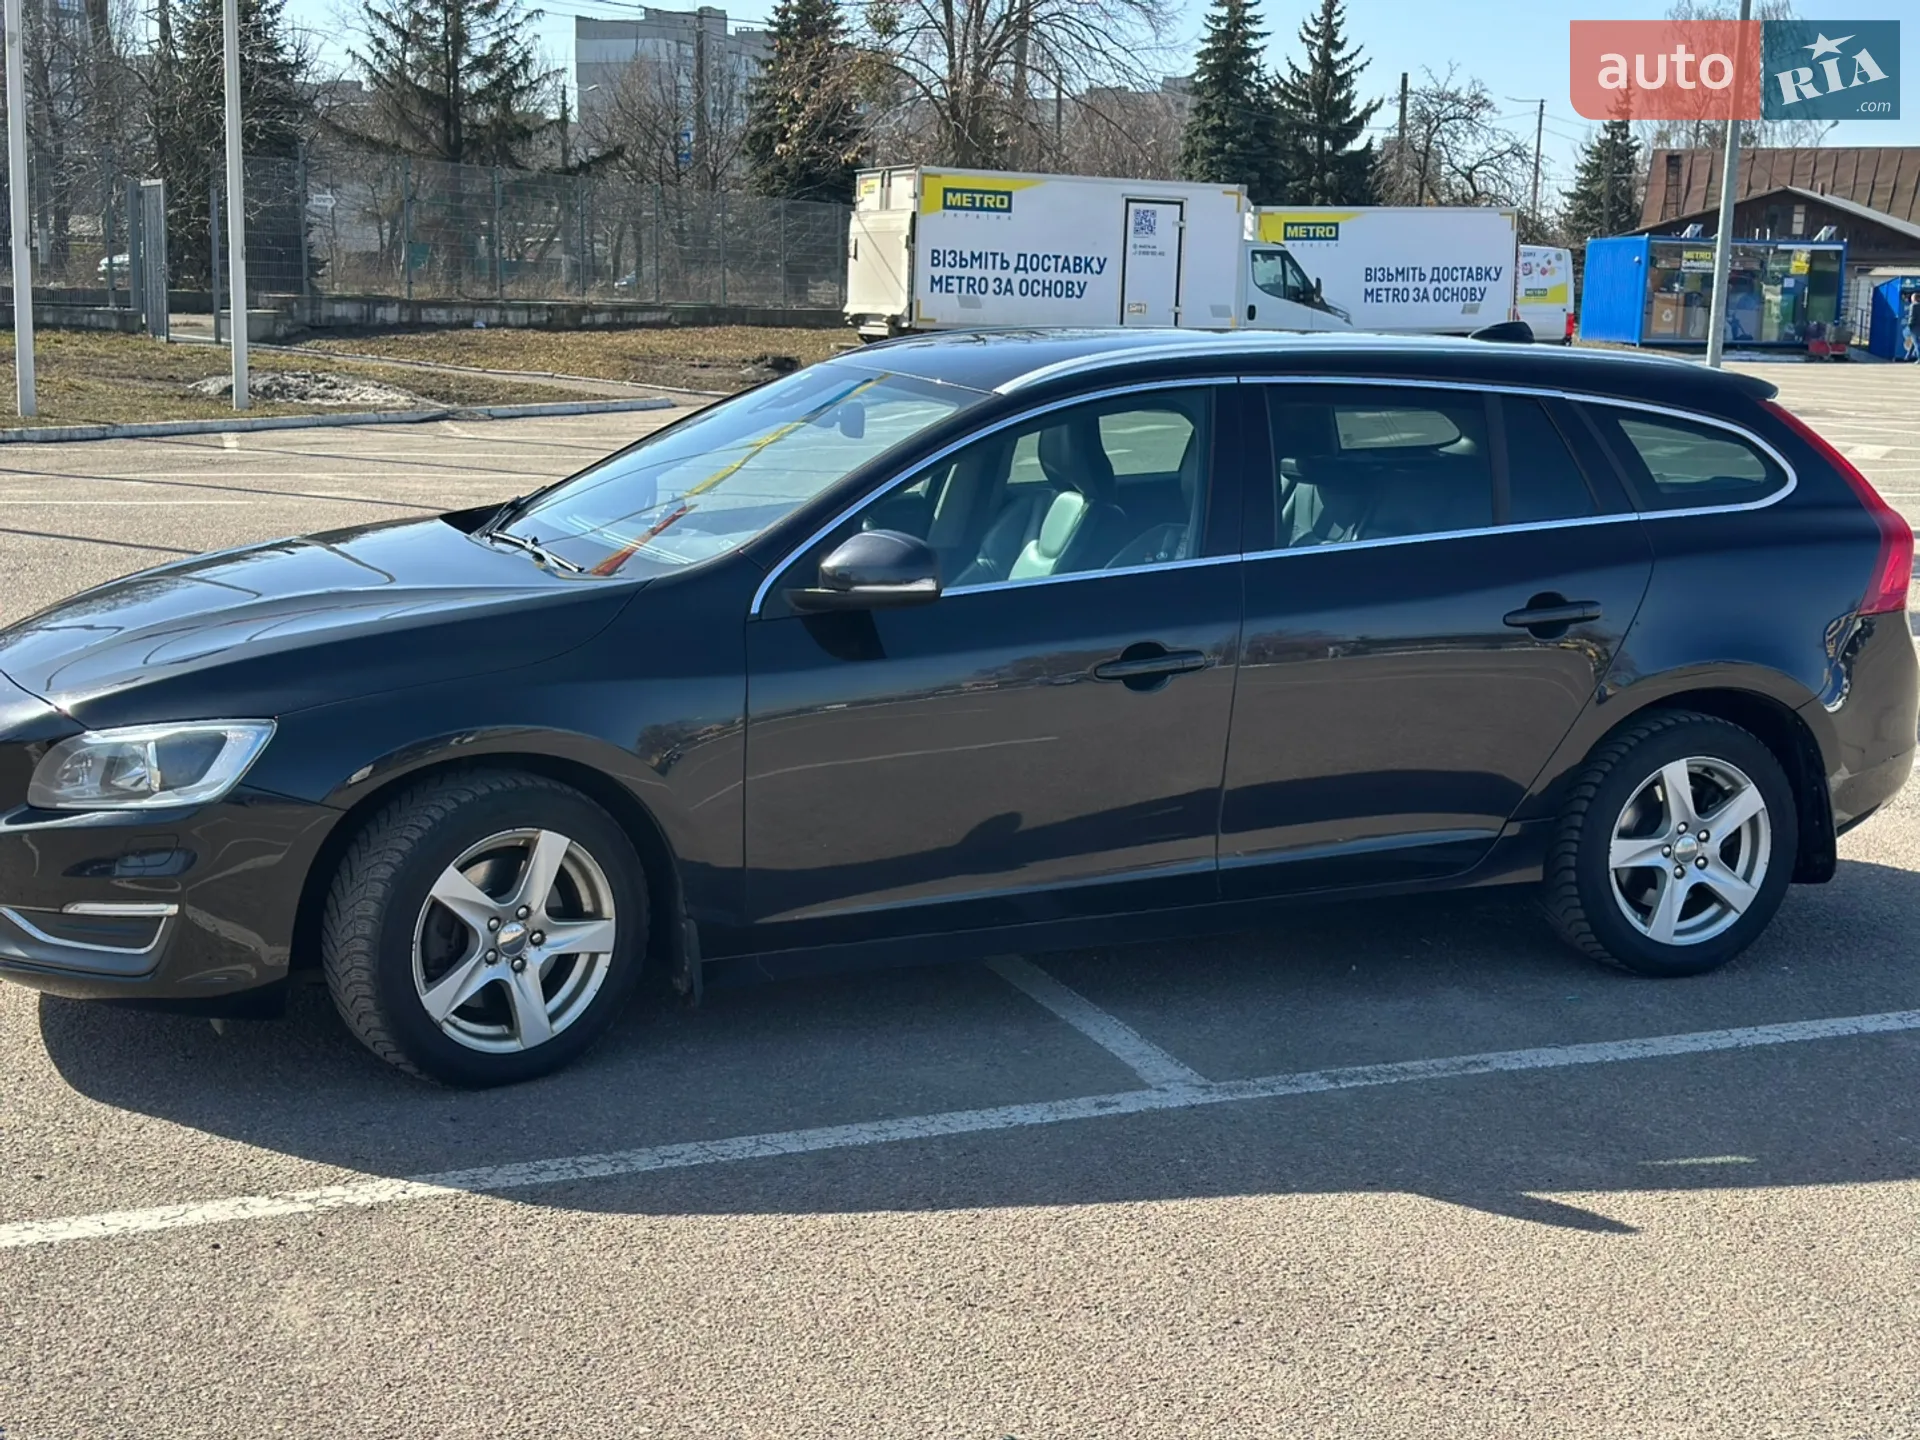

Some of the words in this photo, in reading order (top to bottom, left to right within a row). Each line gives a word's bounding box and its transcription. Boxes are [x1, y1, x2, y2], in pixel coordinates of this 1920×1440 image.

[946, 192, 1009, 209] METRO
[1286, 225, 1337, 238] METRO
[930, 249, 1010, 271] ВІЗЬМІТЬ
[1014, 253, 1107, 275] ДОСТАВКУ
[1364, 266, 1427, 283] ВІЗЬМІТЬ
[1429, 266, 1503, 285] ДОСТАВКУ
[930, 275, 989, 296] METRO
[992, 277, 1014, 297] ЗА
[1018, 279, 1088, 299] ОСНОВУ
[1363, 287, 1410, 304] METRO
[1412, 287, 1430, 303] ЗА
[1433, 286, 1487, 303] ОСНОВУ
